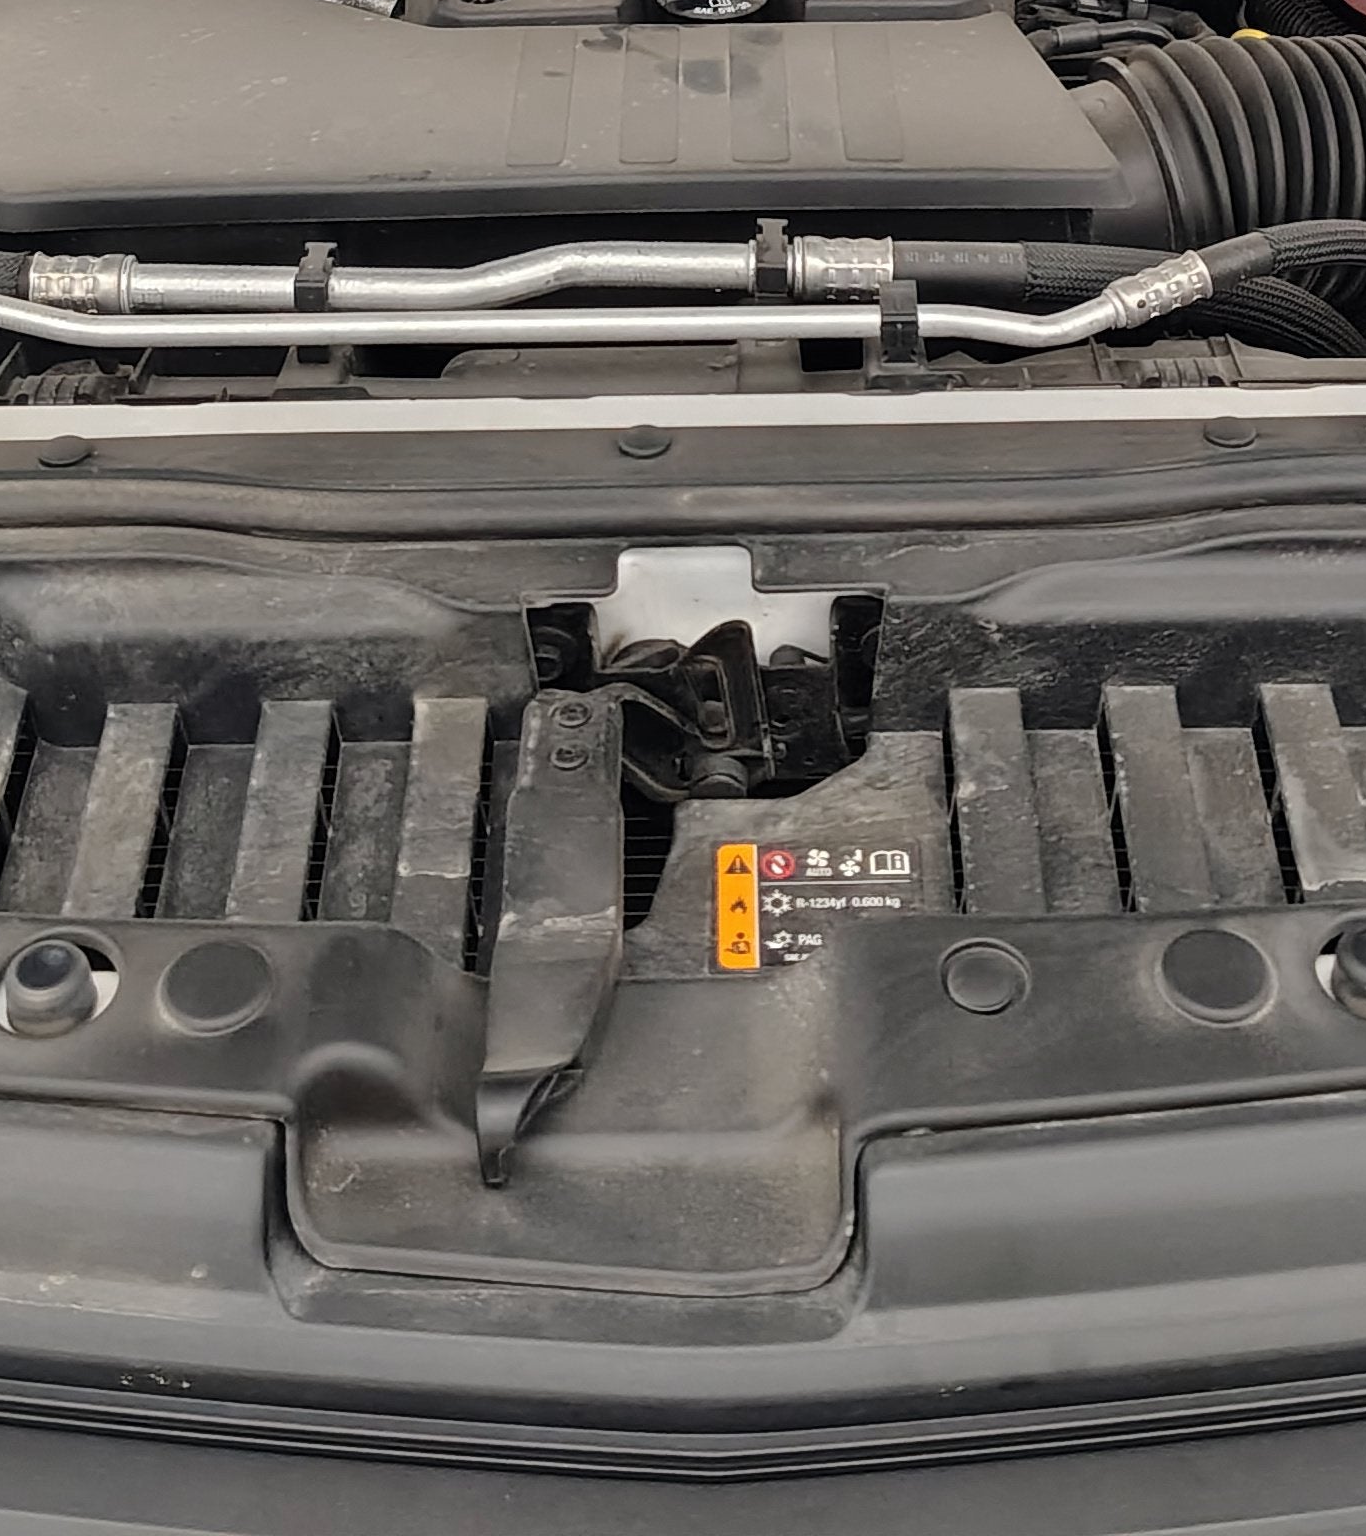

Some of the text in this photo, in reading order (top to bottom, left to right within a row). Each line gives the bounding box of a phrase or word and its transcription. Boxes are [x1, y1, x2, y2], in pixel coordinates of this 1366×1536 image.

[805, 867, 833, 877] AUTO
[795, 896, 847, 910] R-1234yf
[885, 895, 901, 909] kg
[797, 933, 823, 946] PAG
